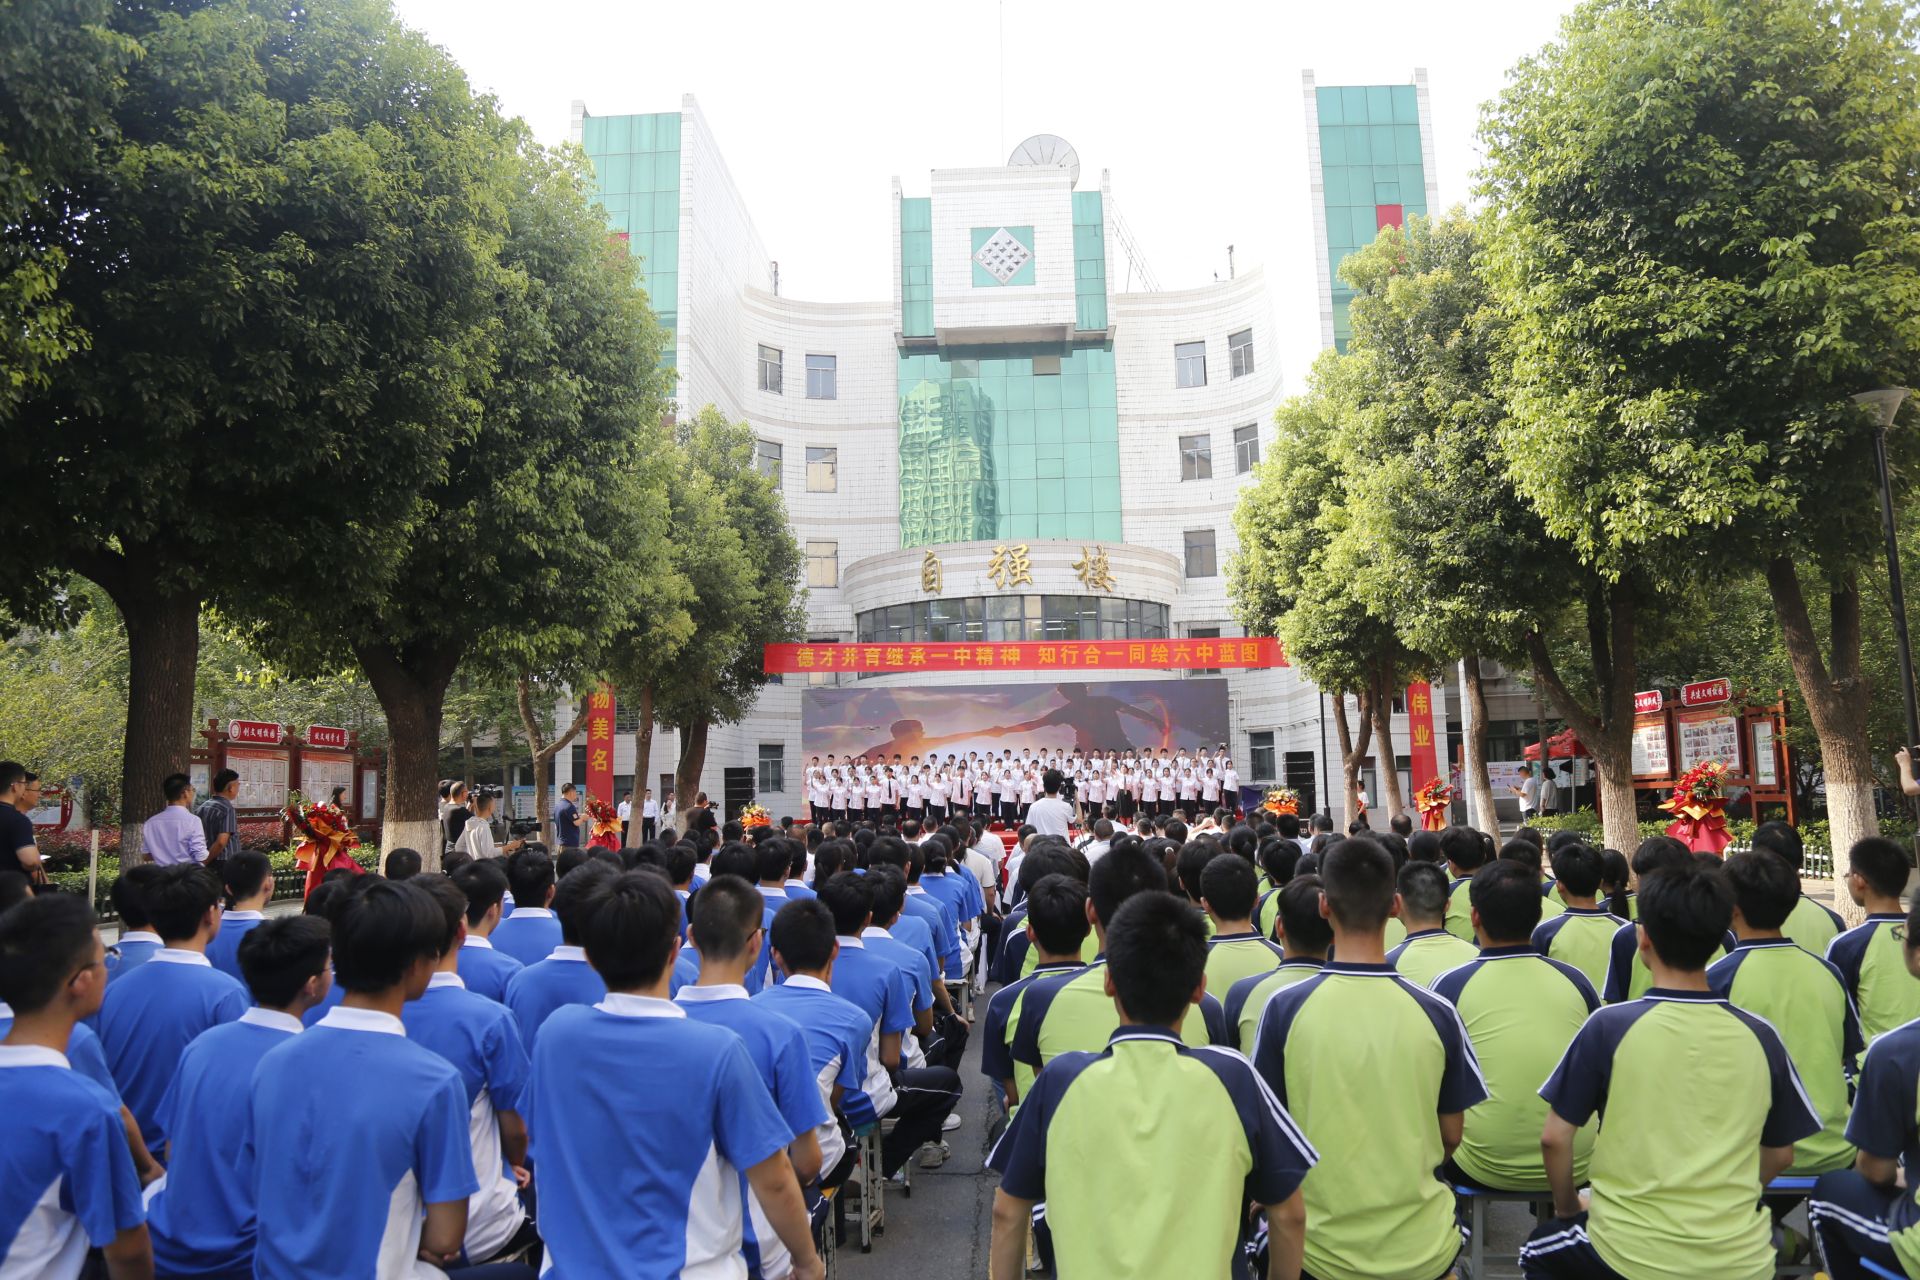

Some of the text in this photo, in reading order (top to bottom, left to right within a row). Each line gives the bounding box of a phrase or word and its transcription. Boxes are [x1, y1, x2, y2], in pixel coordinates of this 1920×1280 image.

[796, 642, 1259, 668] 德才并育继承一中精神 知行合一同绘六中蓝图
